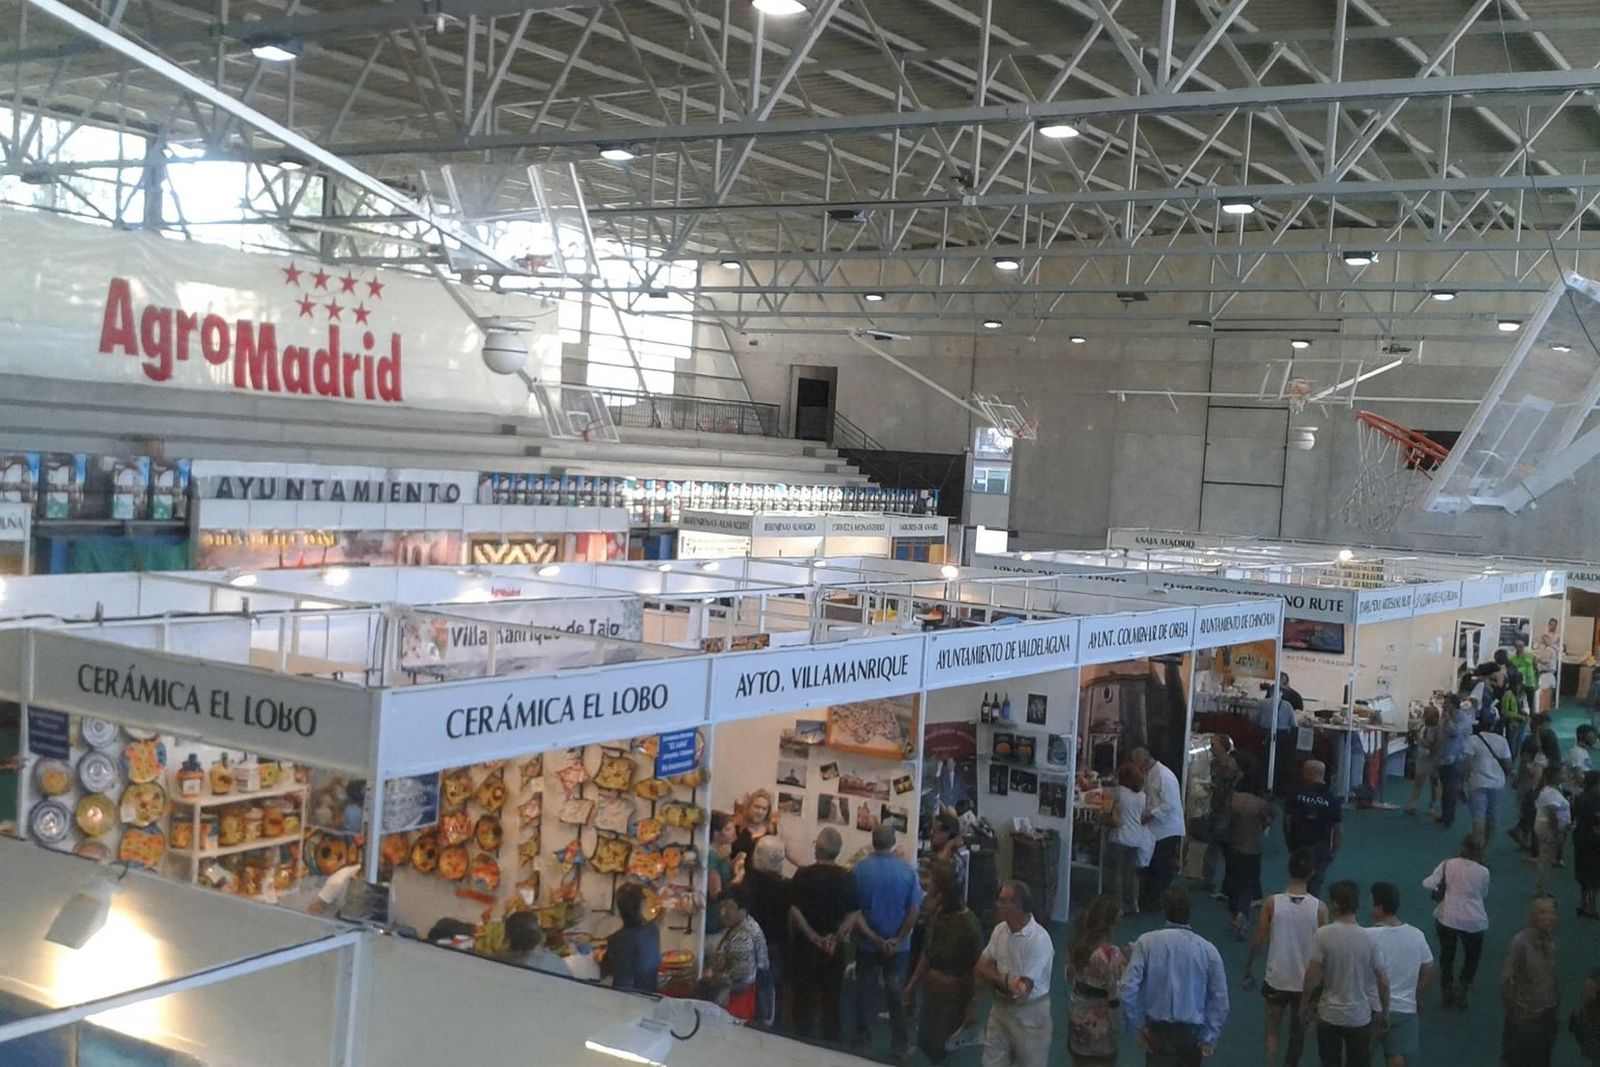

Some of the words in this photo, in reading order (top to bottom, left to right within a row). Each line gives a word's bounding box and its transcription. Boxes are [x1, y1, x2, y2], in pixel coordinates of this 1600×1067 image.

[99, 276, 404, 402] AgroMadrid
[215, 475, 463, 504] AYUNTAMIENTO
[1309, 597, 1345, 613] RUTE
[1159, 623, 1168, 640] DE
[936, 642, 1002, 670] AYUNTAMIENTO
[1005, 641, 1016, 659] DE
[791, 654, 909, 690] VILLAMANRIQUE
[78, 663, 201, 716] CERÁMICA
[210, 689, 235, 720] EL
[446, 693, 575, 739] CERÁMICA
[583, 693, 604, 720] EL
[612, 683, 669, 715] LOBO
